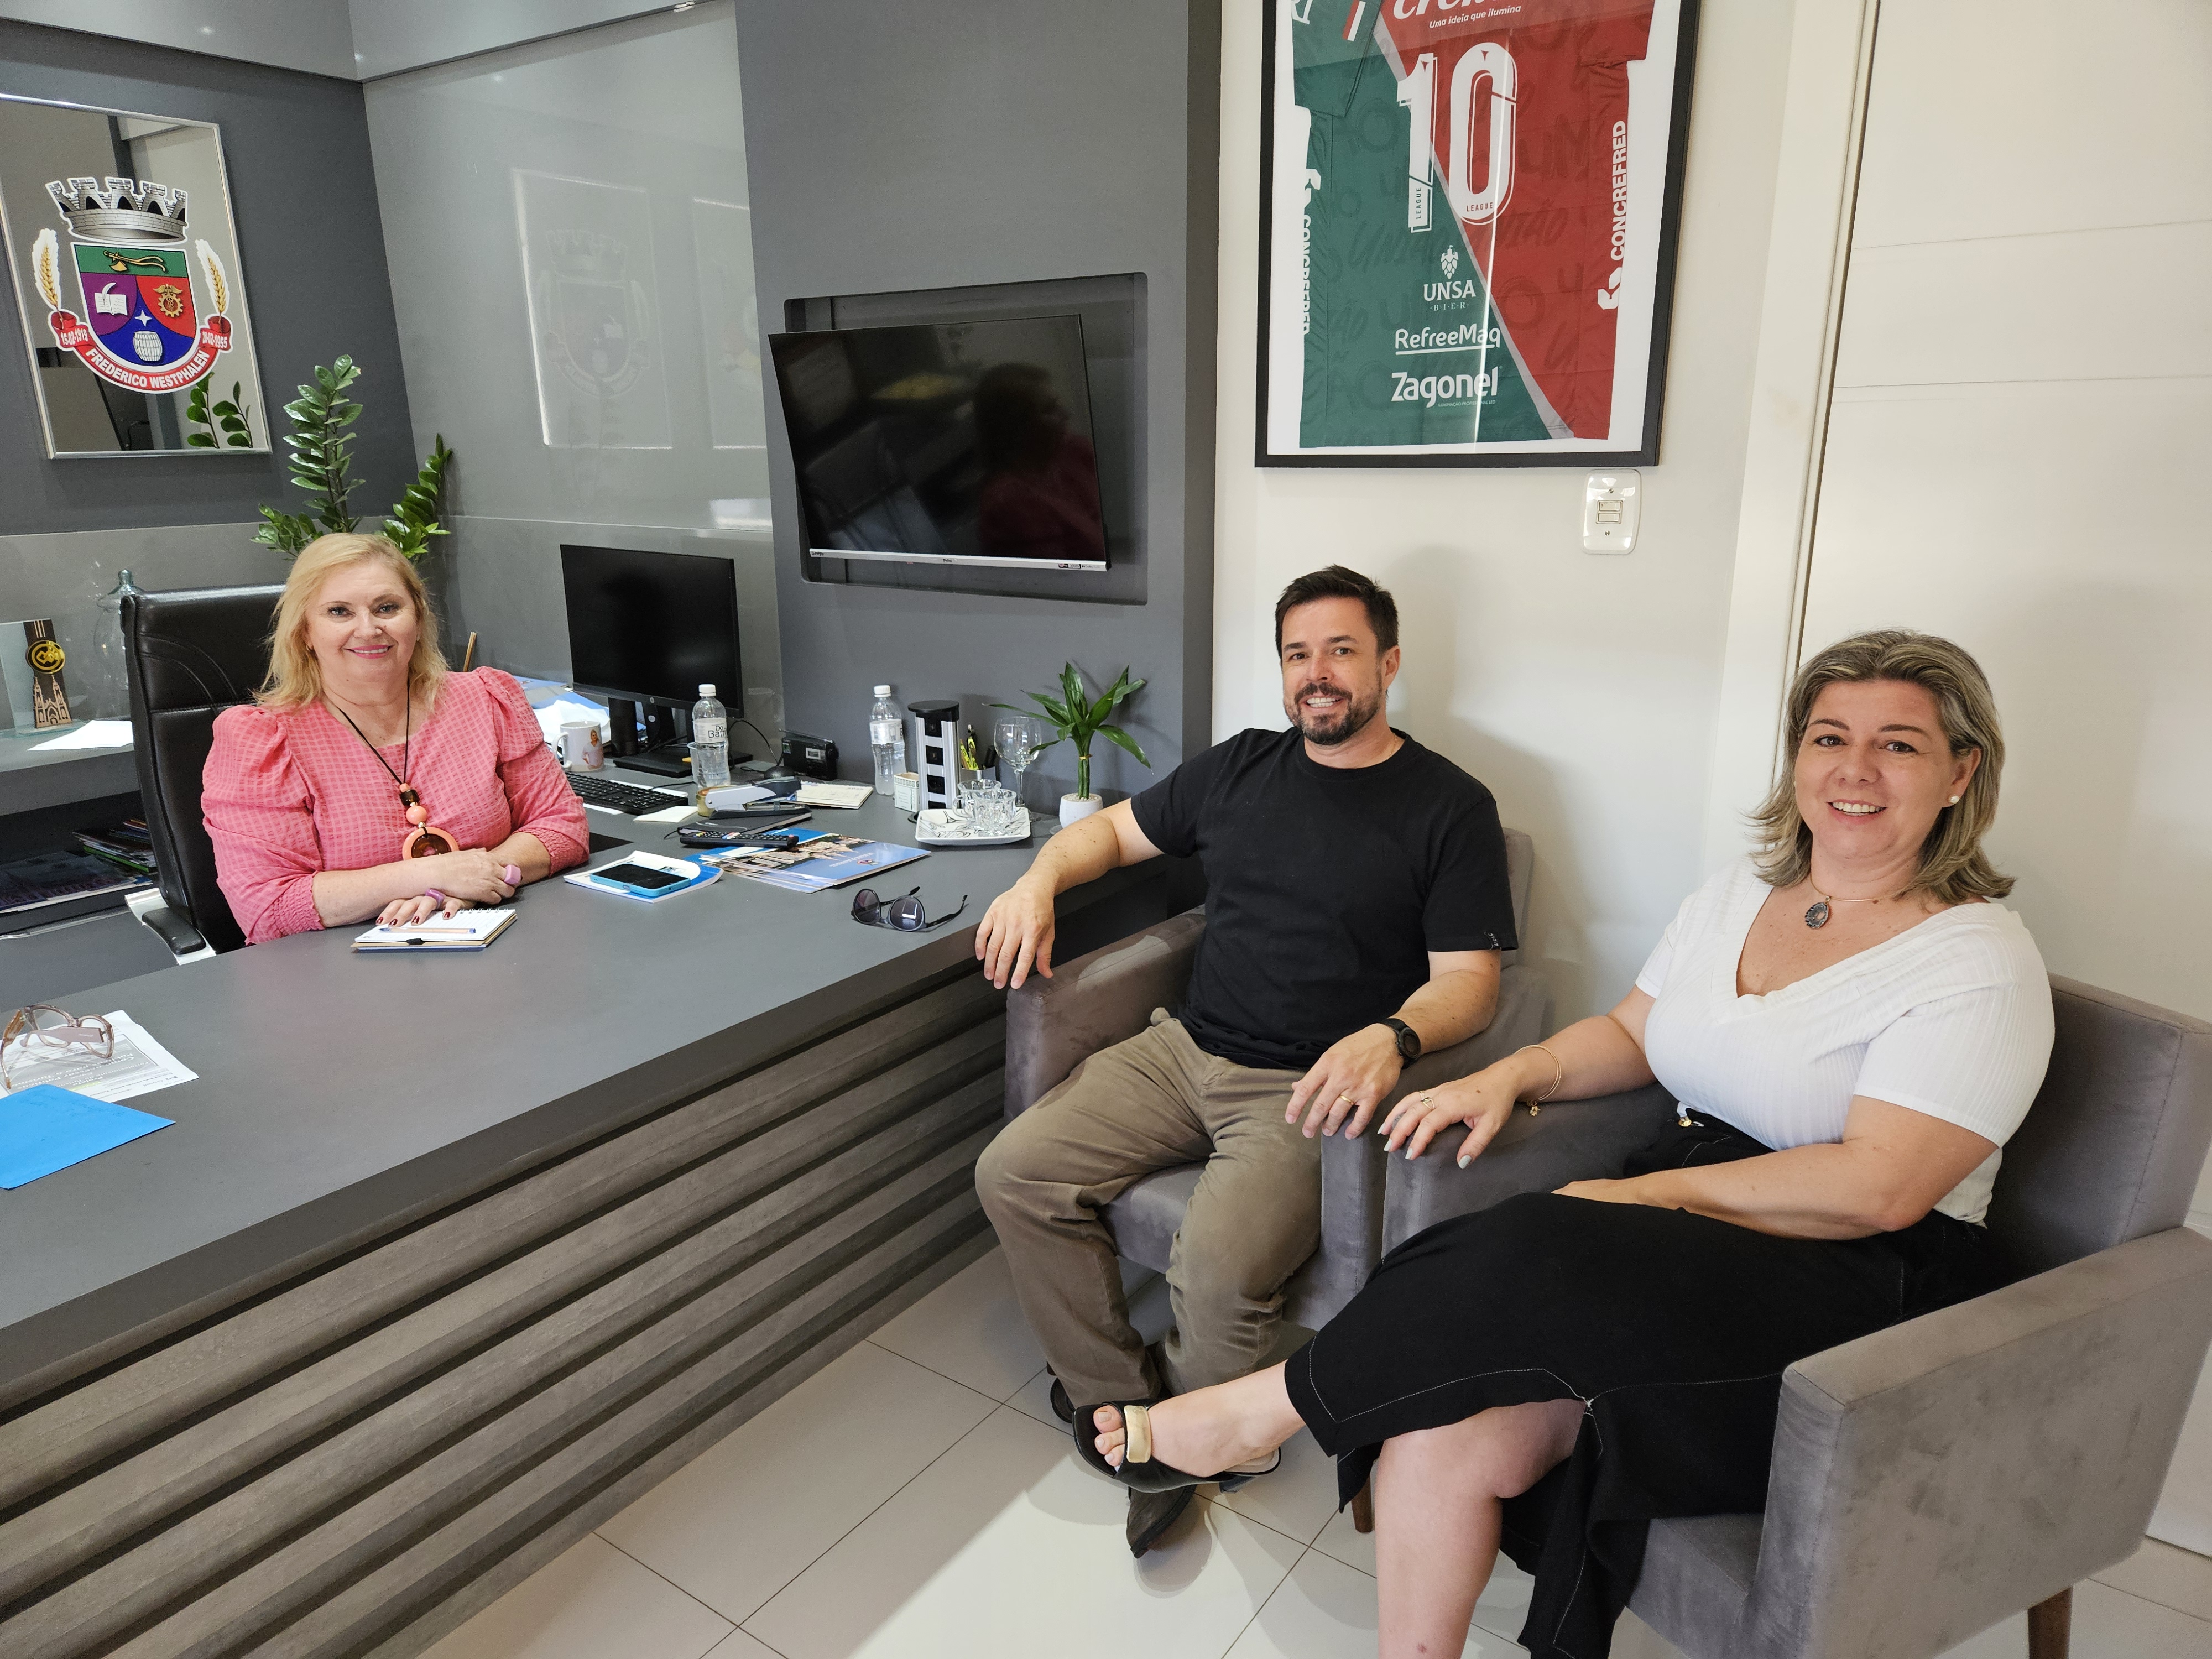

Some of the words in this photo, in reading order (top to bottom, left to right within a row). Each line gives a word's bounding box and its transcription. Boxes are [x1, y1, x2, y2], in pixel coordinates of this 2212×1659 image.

[1429, 19, 1446, 28] Uma
[1448, 14, 1469, 24] ideia
[1470, 12, 1486, 22] que
[1488, 6, 1521, 17] ilumina
[1397, 42, 1517, 233] 10
[1467, 202, 1493, 212] LEAGUE
[1610, 121, 1626, 261] CONCREFRED
[1423, 279, 1476, 301] UNSA
[1395, 324, 1500, 349] RefreeMaq
[85, 348, 147, 387] FREDERICO
[149, 349, 210, 389] WESTPHALEN
[1391, 366, 1498, 408] Zagonel
